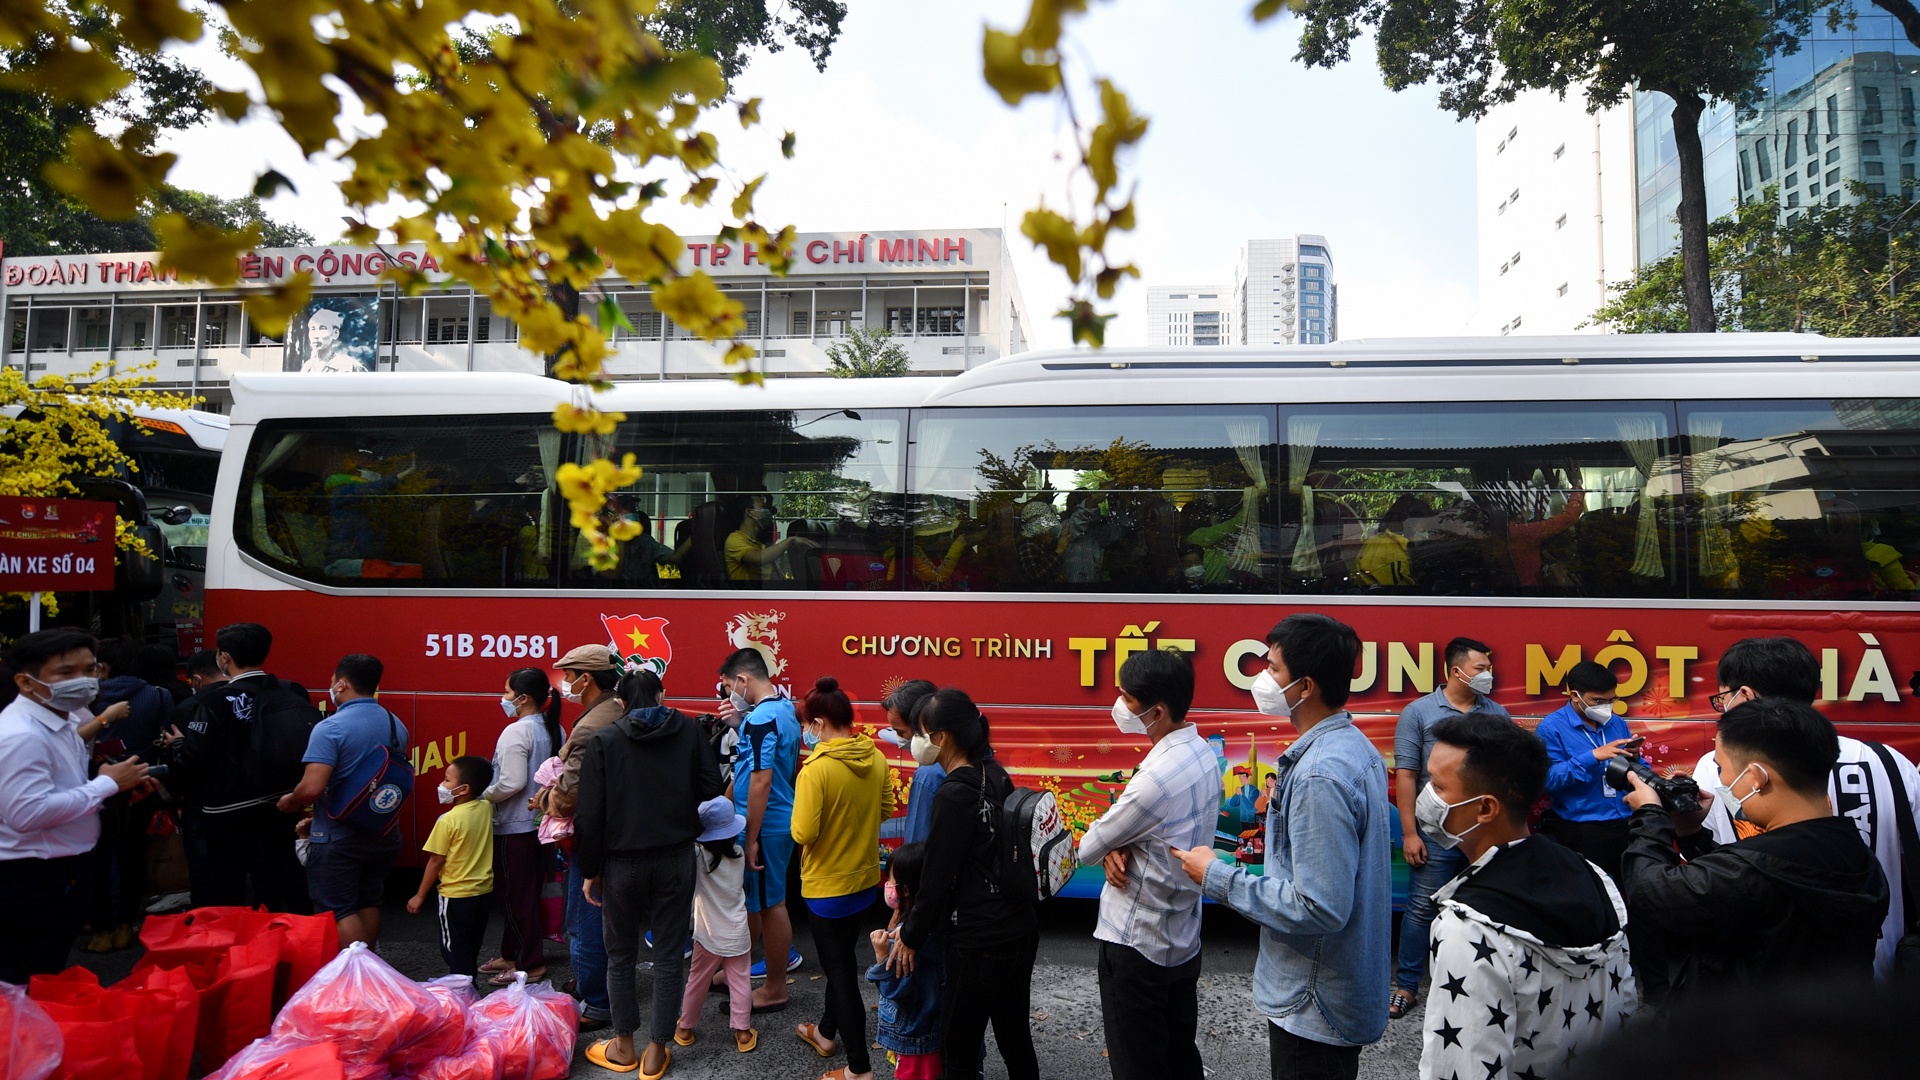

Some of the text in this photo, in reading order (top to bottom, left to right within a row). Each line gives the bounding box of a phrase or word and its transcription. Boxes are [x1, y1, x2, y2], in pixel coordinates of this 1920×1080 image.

[5, 258, 87, 286] ĐOÀN
[95, 260, 177, 283] THAN
[294, 248, 387, 283] CỘNG
[806, 233, 866, 264] CHÍ
[879, 237, 966, 263] MINH
[27, 557, 47, 574] XE
[52, 552, 73, 574] SỐ
[76, 557, 95, 574] 04
[425, 633, 559, 658] 51B 20581
[842, 633, 1051, 659] CHƯƠNG TRÌNH
[1224, 639, 1493, 693] CUN
[1526, 630, 1698, 715] MỘT
